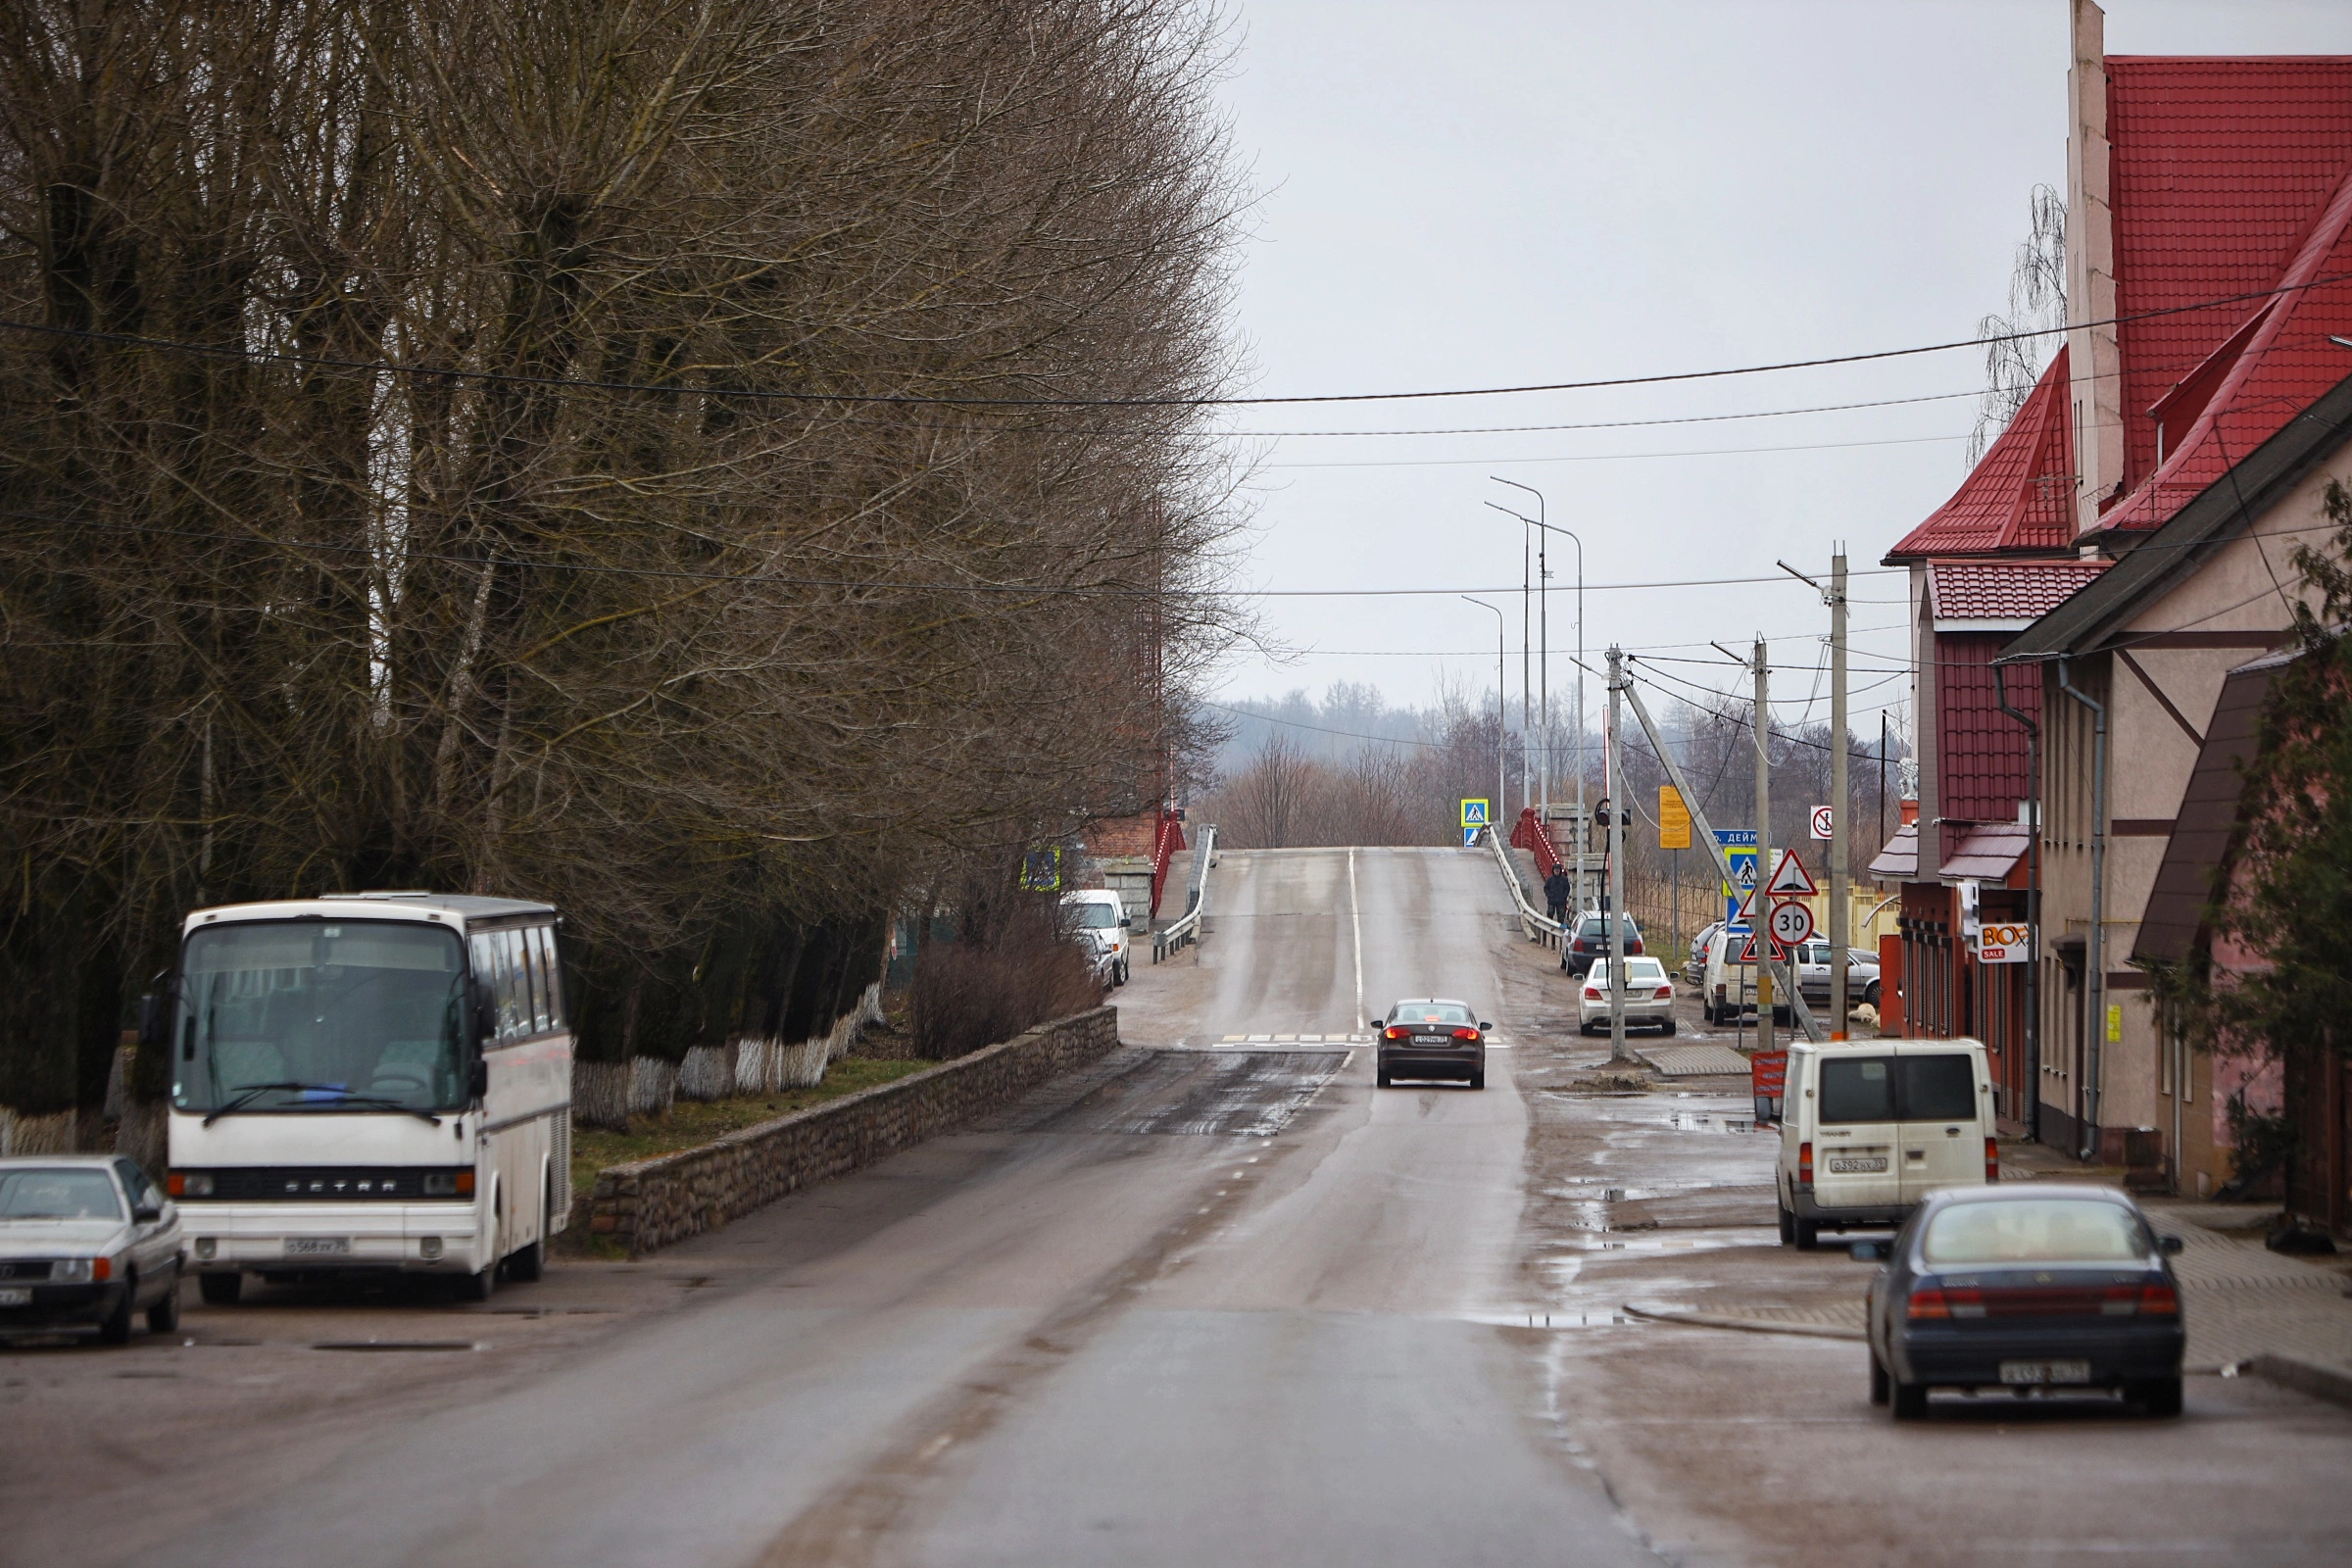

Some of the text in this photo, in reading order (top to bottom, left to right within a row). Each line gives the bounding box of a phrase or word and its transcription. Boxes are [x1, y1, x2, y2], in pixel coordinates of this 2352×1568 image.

[1728, 832, 1758, 843] ДЕЙМ
[1780, 914, 1804, 932] 30
[285, 1179, 397, 1193] SETRA
